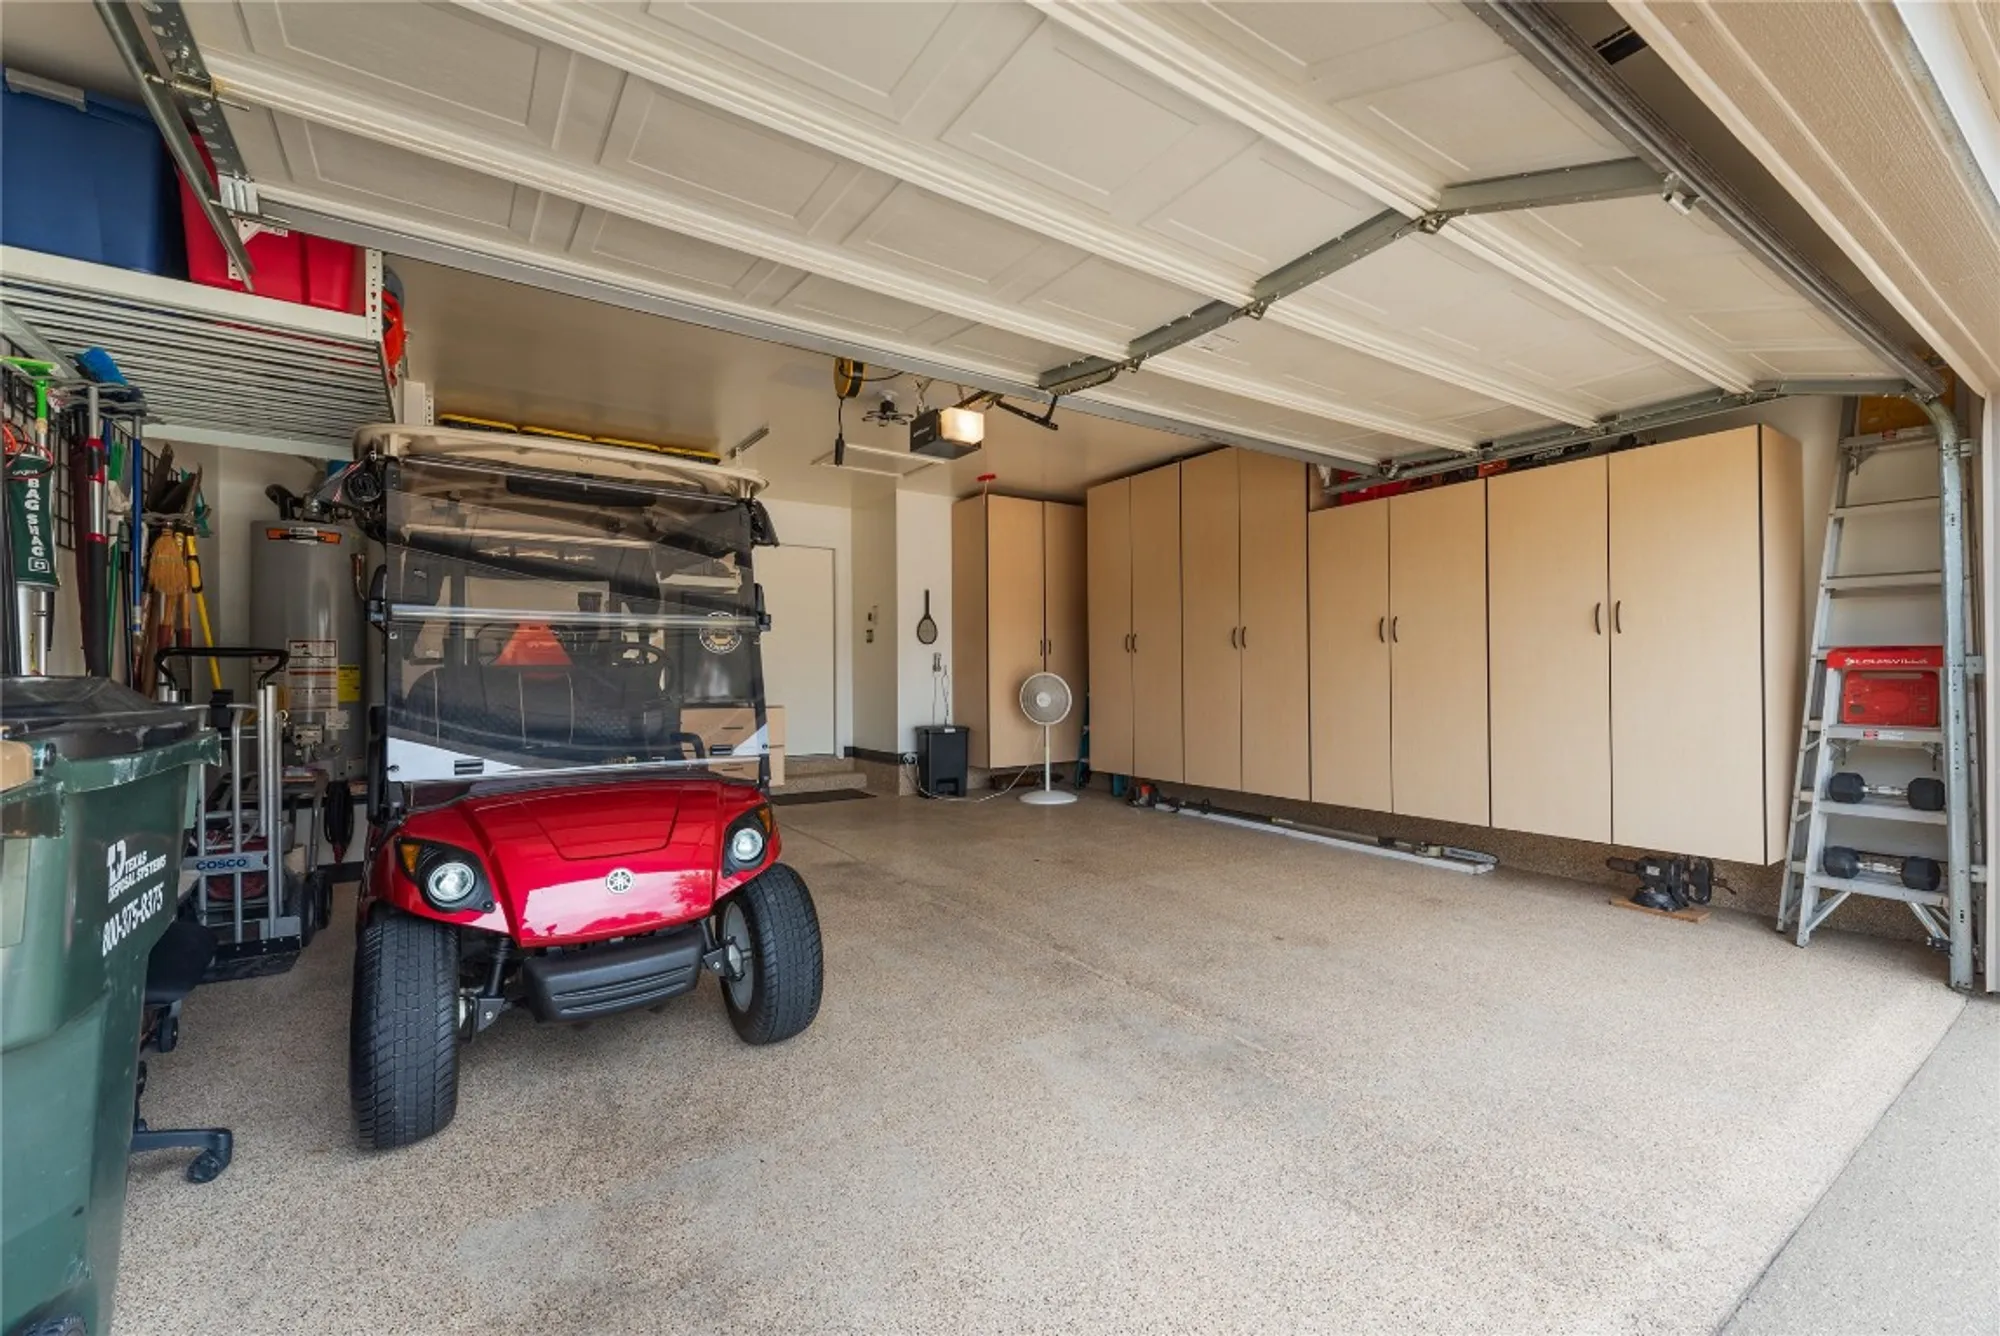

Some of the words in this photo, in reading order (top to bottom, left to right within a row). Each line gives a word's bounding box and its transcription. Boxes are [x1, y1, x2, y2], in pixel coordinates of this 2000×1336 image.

[24, 478, 40, 511] BAG
[108, 871, 136, 903] DISPOSAL
[136, 853, 167, 881] SYSTEMS
[125, 850, 148, 874] TEXAS
[196, 858, 247, 870] COSCO
[103, 881, 165, 957] 800-375-8375
